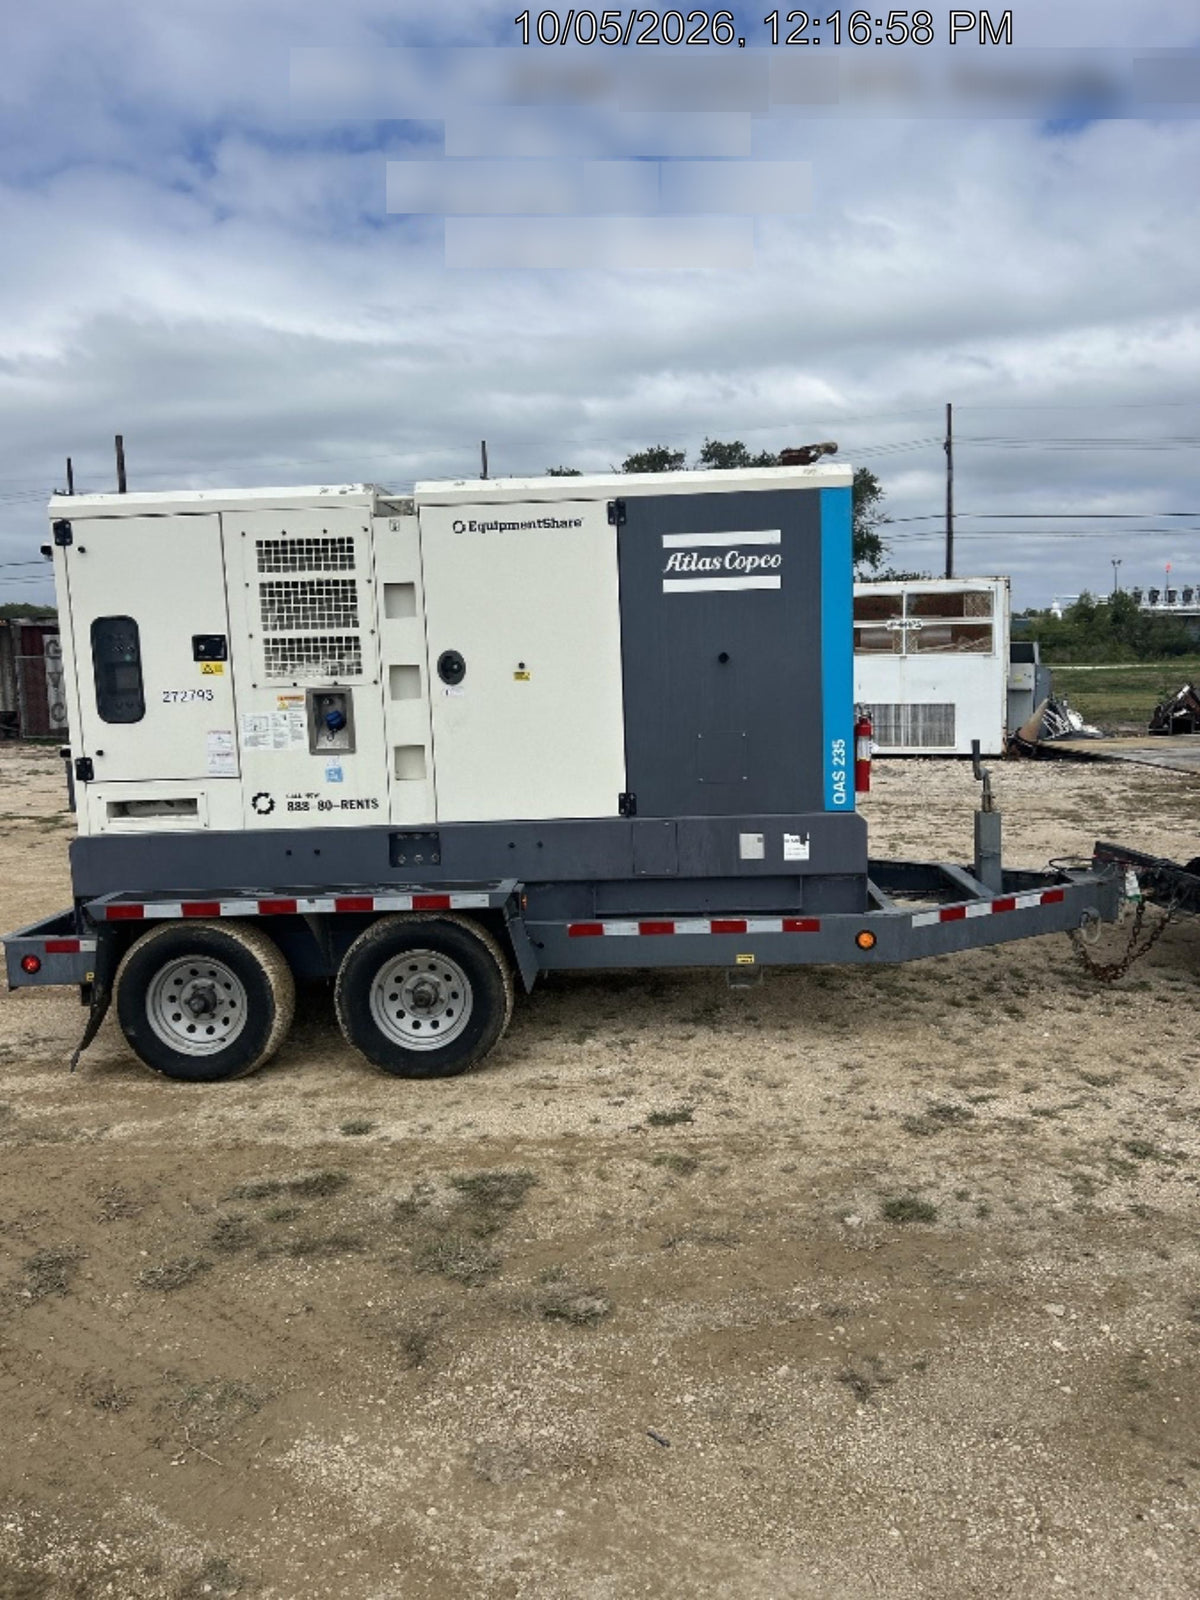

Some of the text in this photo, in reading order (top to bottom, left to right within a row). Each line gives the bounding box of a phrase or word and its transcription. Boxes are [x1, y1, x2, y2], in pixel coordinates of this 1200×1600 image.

[468, 517, 582, 534] EquipmentShare
[663, 550, 781, 573] Atlas Copco
[162, 689, 214, 703] 272793
[832, 739, 847, 805] QAS 235
